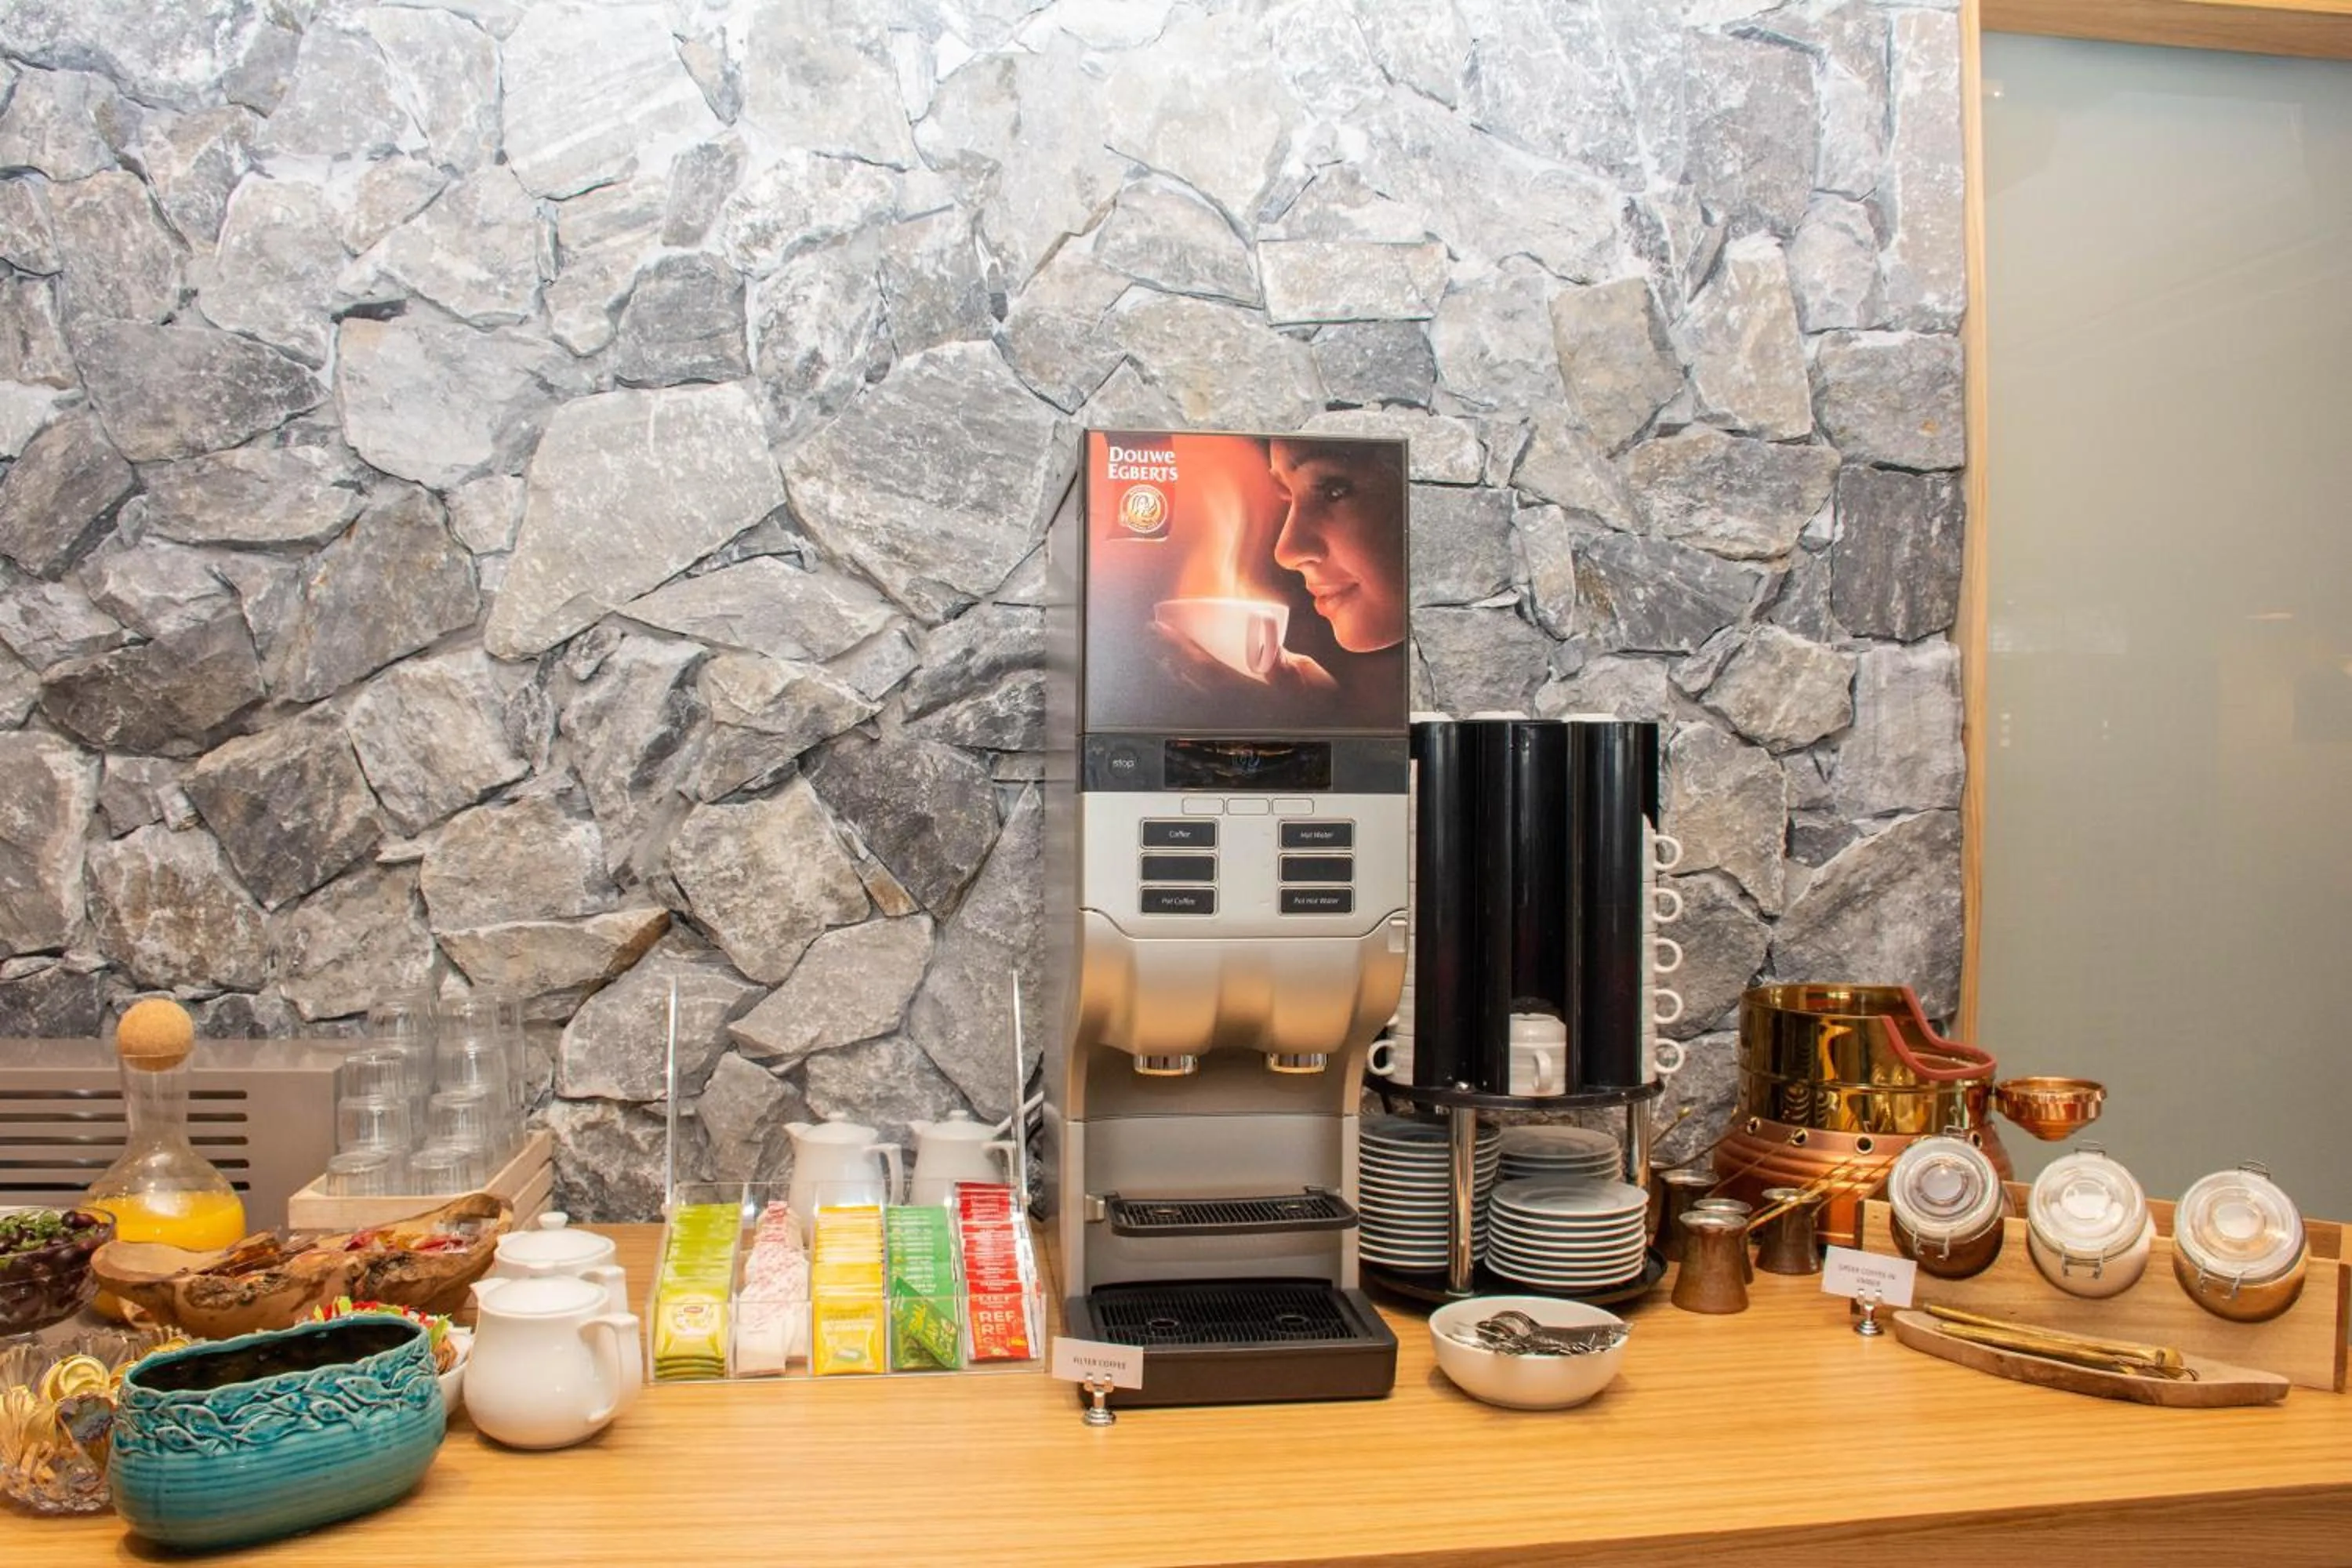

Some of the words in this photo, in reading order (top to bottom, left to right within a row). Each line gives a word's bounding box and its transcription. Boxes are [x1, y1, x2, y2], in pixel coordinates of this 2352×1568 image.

[1108, 463, 1178, 483] EGBERTS
[1112, 758, 1135, 769] stop
[1073, 1357, 1097, 1366] FILTER
[1098, 1359, 1126, 1370] COFFEE
